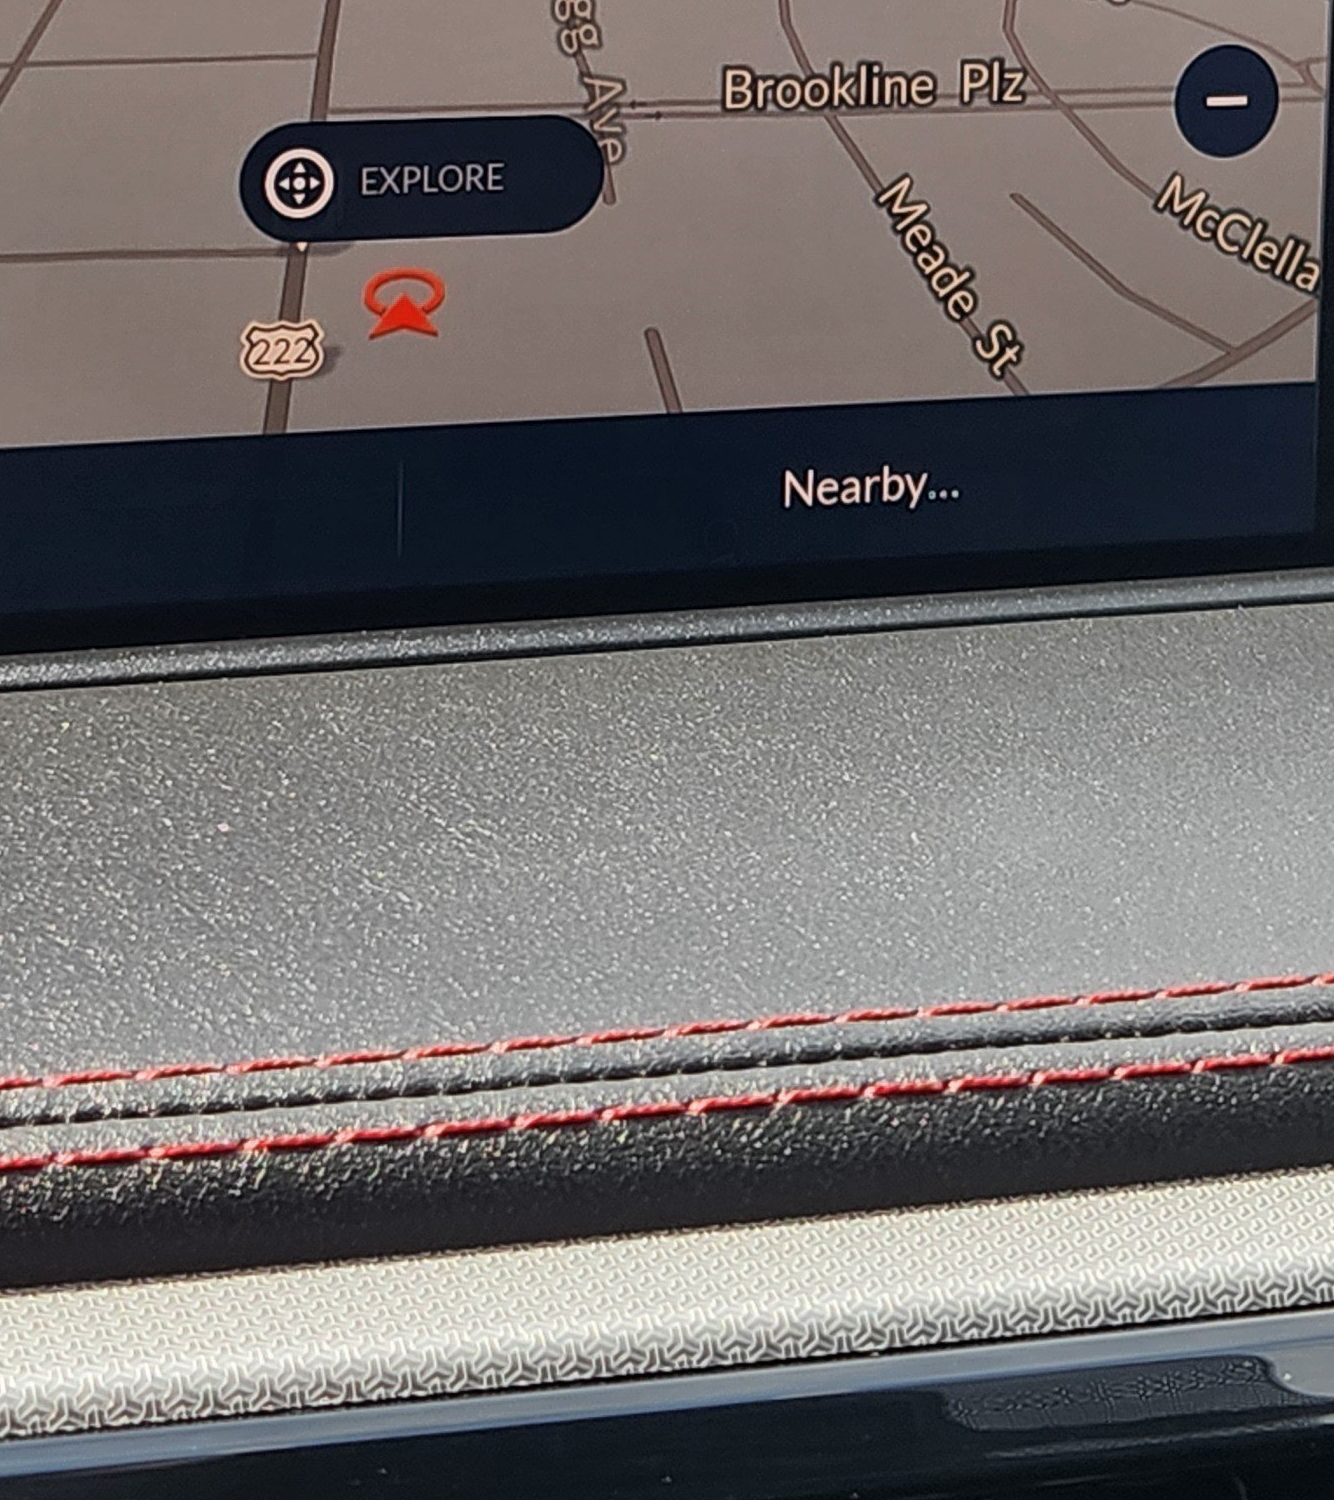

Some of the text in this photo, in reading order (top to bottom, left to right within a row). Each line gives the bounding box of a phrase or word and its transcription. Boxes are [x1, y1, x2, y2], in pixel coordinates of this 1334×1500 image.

[722, 58, 1029, 112] Brookline Plz
[582, 74, 626, 166] Ave
[360, 161, 505, 196] EXPLORE
[1155, 171, 1322, 294] McClella
[876, 174, 1024, 378] Meade St
[252, 336, 314, 366] 222
[782, 464, 961, 509] Nearby...
